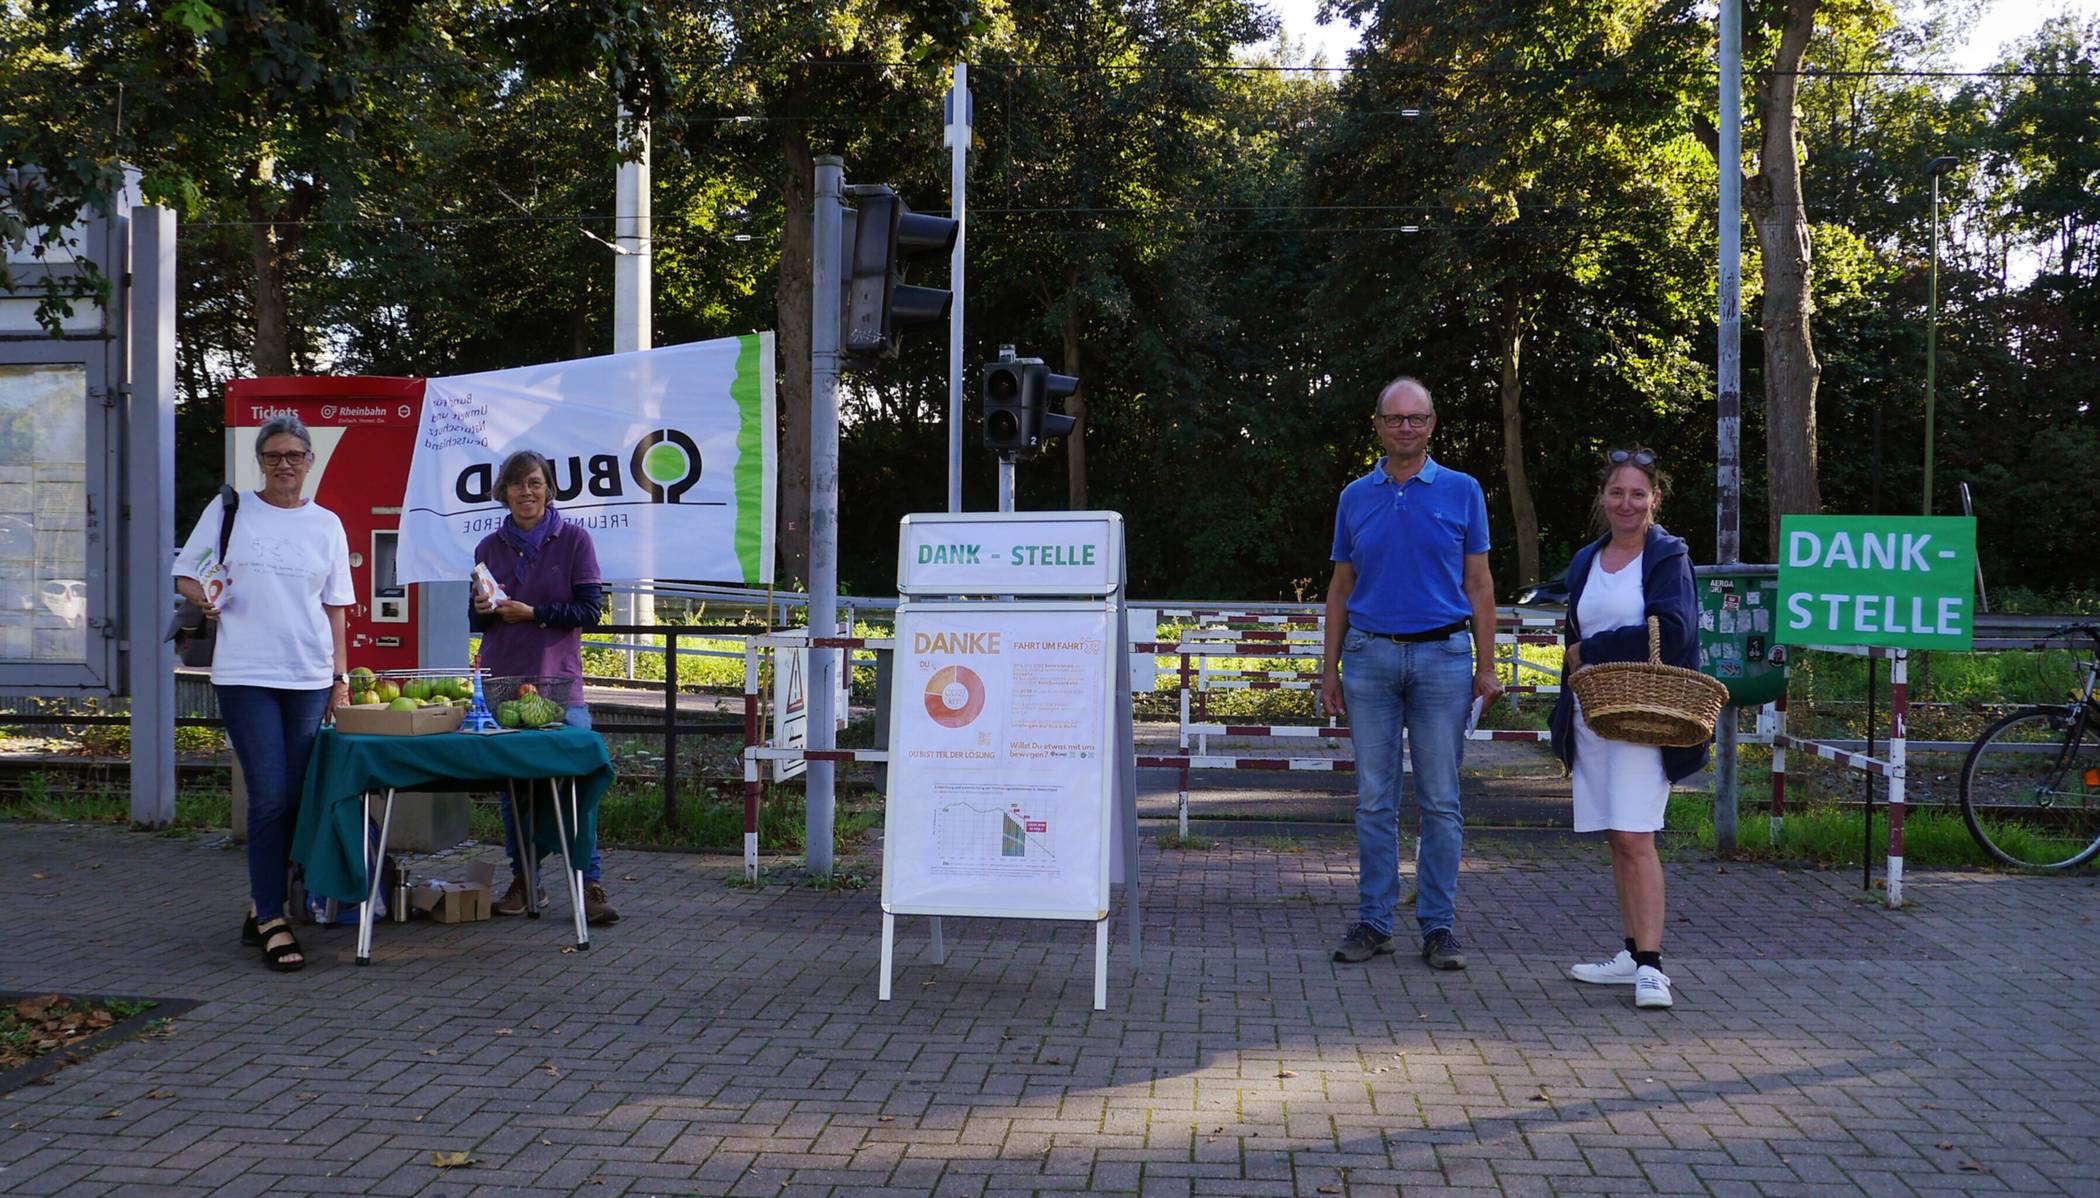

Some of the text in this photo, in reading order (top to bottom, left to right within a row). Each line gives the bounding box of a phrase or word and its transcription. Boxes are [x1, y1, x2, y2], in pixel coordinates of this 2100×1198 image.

[251, 406, 298, 419] Tickets
[339, 405, 387, 416] Rheinbahn
[1030, 437, 1037, 445] 2
[918, 545, 981, 564] DANK
[1011, 545, 1095, 565] STELLE
[1789, 531, 1956, 571] DANK-
[1788, 592, 1963, 635] STELLE
[914, 632, 1000, 654] DANKE
[1014, 642, 1084, 651] FAHRT UM FAHRT
